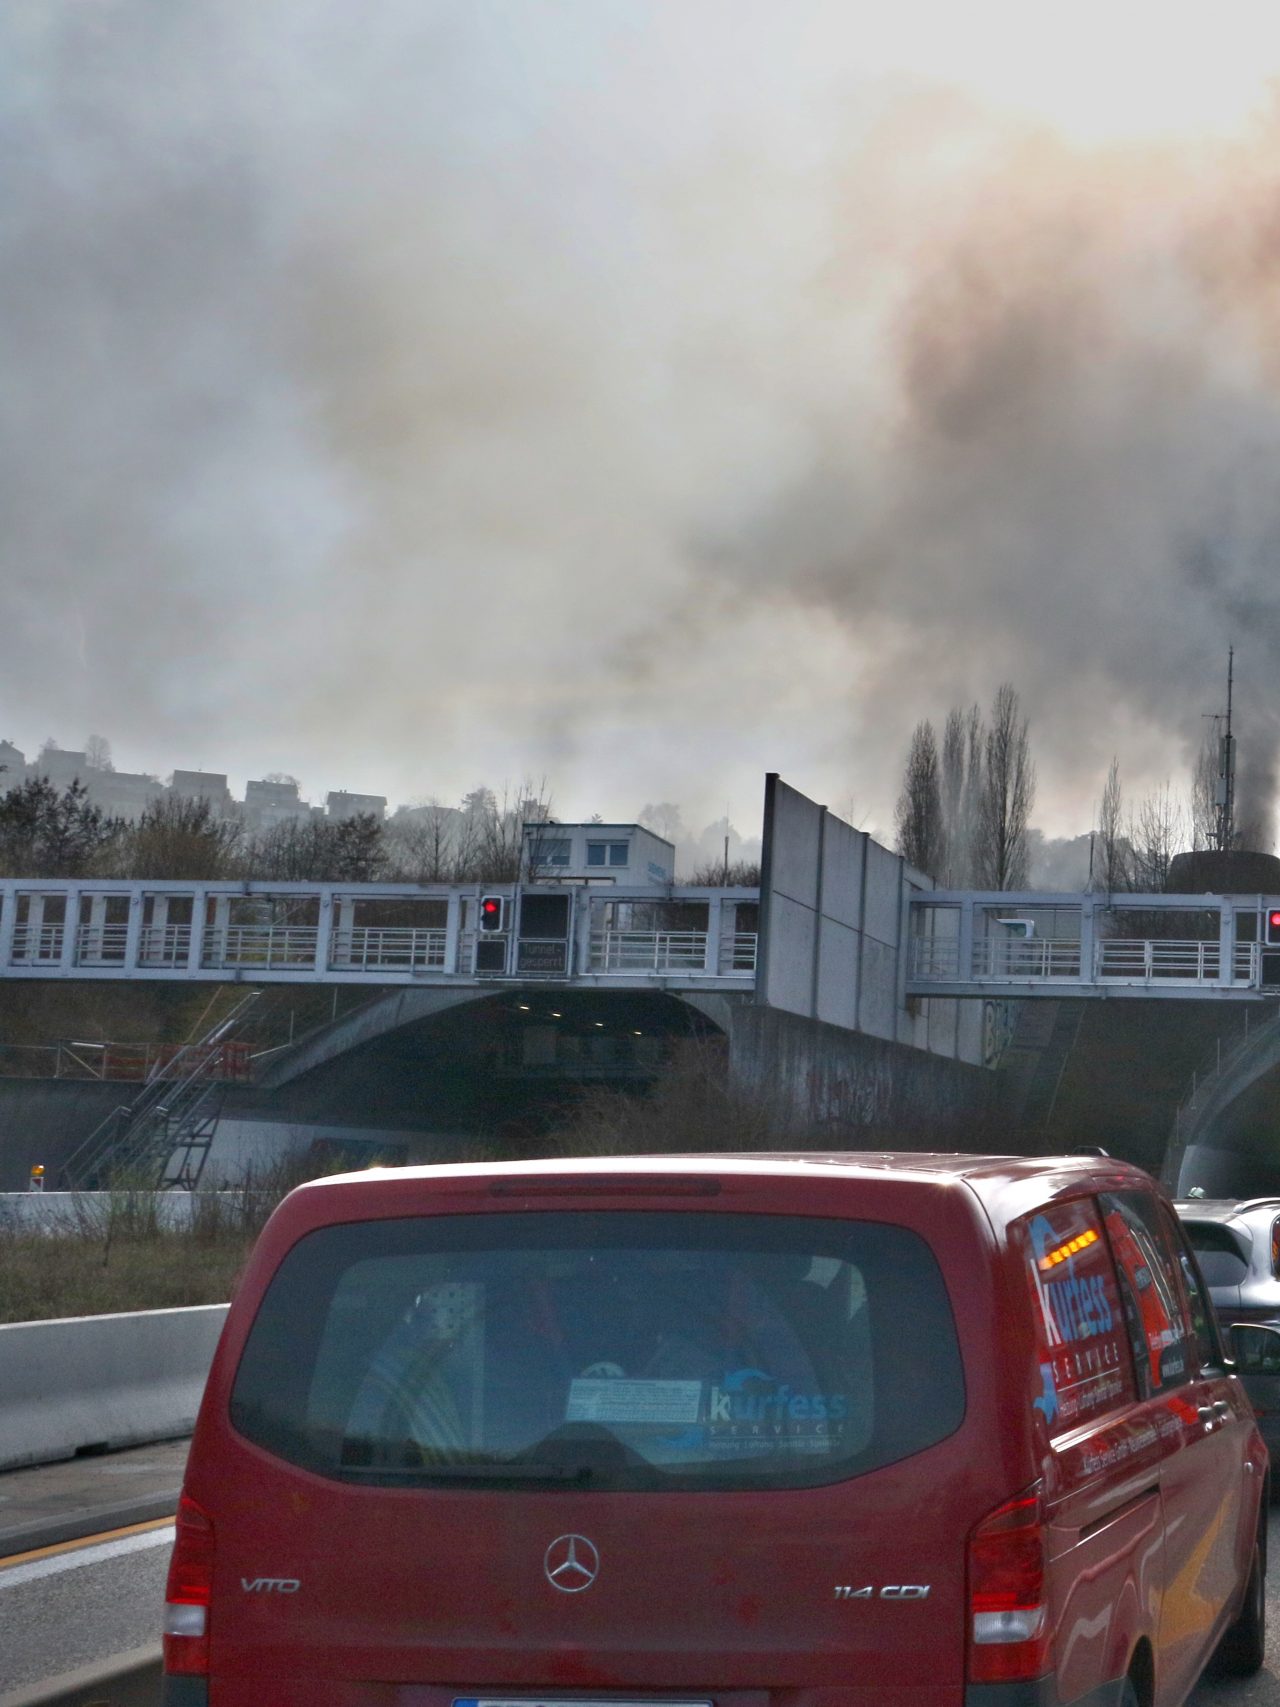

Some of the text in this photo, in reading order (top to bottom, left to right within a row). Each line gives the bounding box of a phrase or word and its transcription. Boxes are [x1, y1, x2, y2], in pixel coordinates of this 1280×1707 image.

[1053, 1342, 1119, 1383] SERVICE
[709, 1425, 844, 1435] SERVICE
[241, 1578, 300, 1592] VITO
[834, 1585, 931, 1600] 114 CDI
